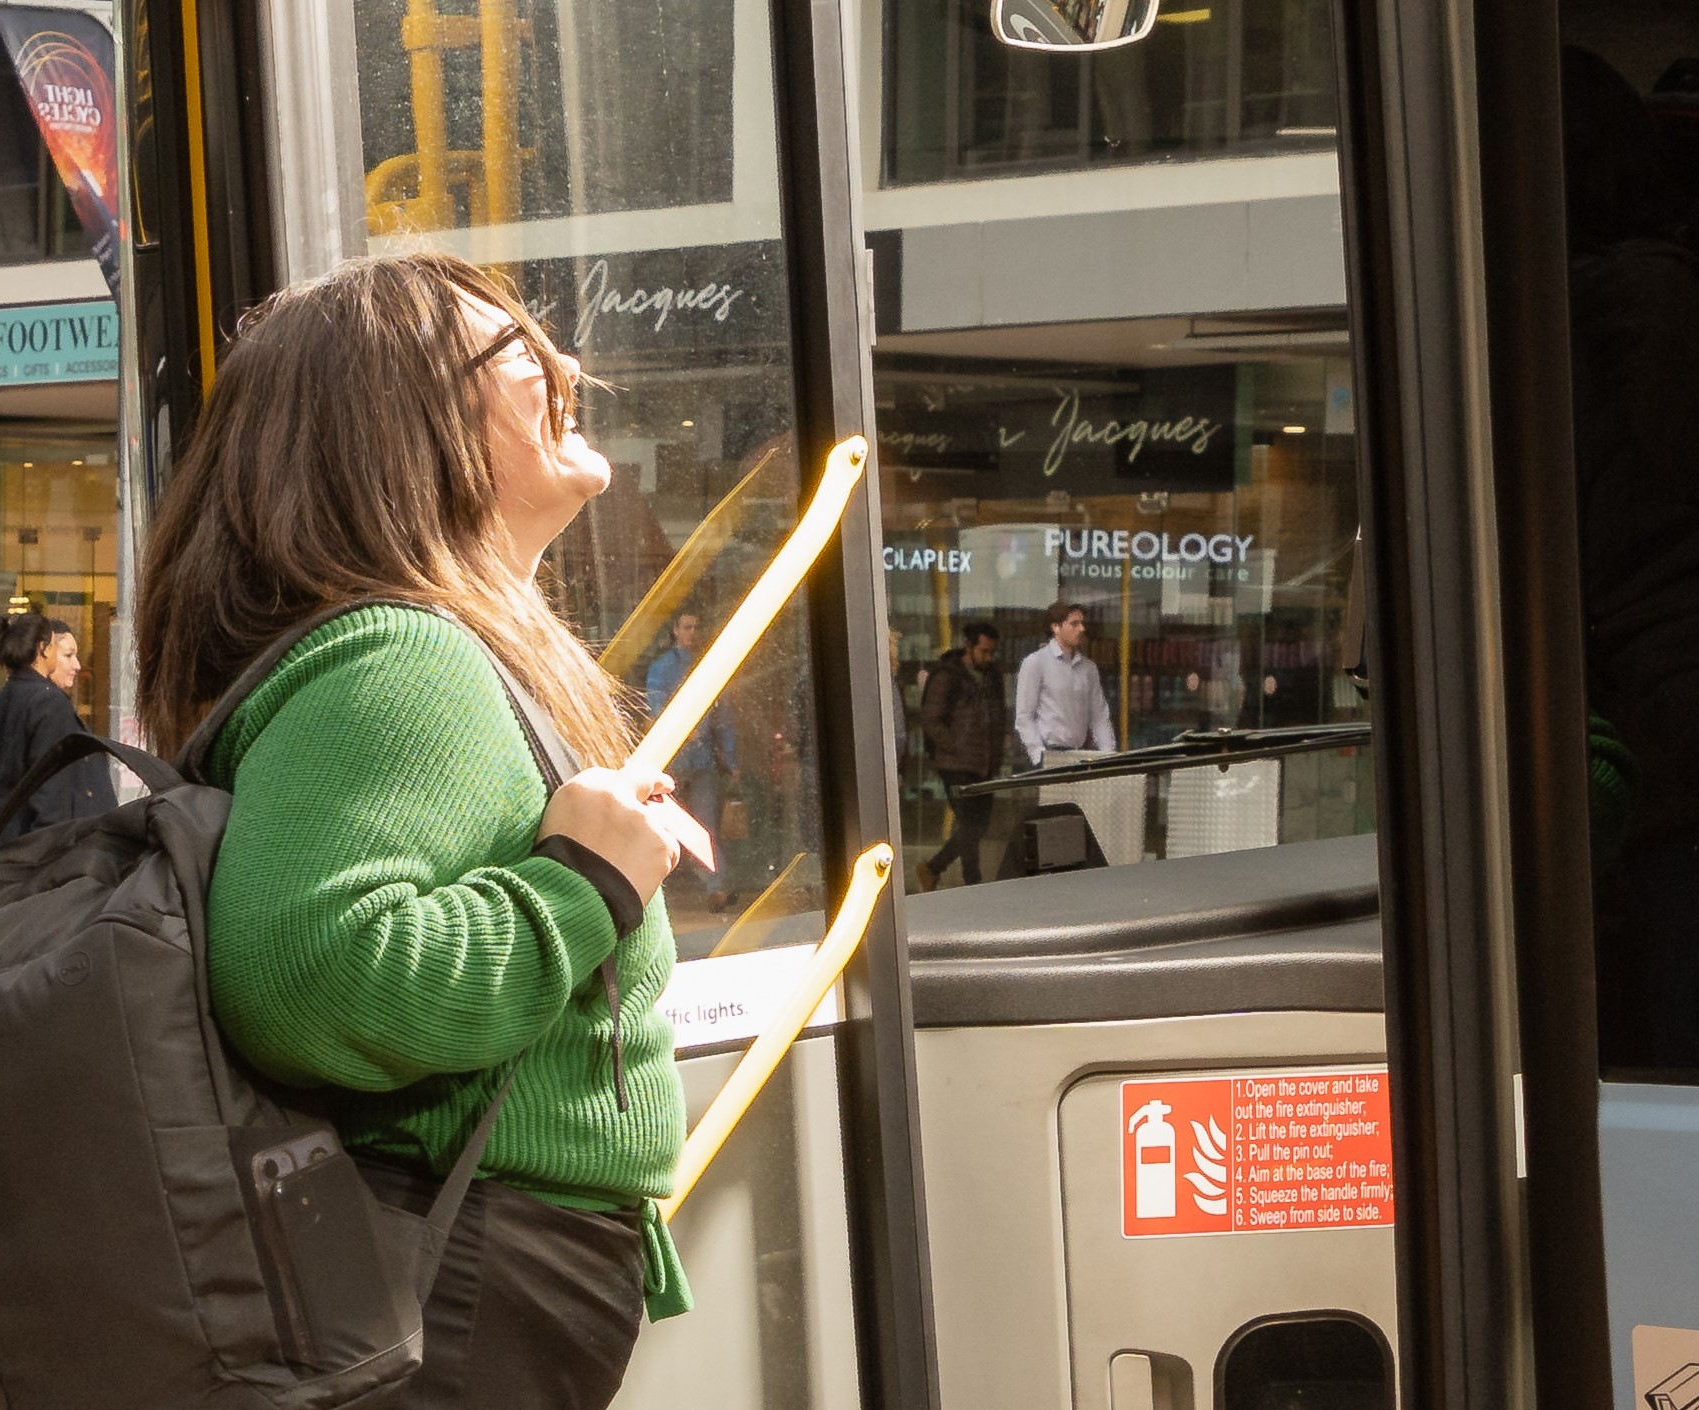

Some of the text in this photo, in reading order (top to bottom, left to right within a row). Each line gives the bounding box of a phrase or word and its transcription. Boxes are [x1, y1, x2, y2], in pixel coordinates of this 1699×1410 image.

[574, 259, 744, 347] Jacques
[24, 364, 49, 376] GIFTS
[1044, 388, 1222, 476] Jacques
[1043, 528, 1254, 564] PUREOLOGY
[1130, 561, 1196, 581] colour
[697, 1001, 749, 1024] lights.
[1235, 1075, 1379, 1100] 1.Open the cover and take
[1235, 1097, 1366, 1120] out the fire extinguisher;
[1235, 1119, 1380, 1141] 2. Lift the fire extinguisher;
[1235, 1142, 1333, 1164] 3. Pull the pin out;
[1235, 1160, 1390, 1183] 4. Aim at the base of the fire;
[1235, 1181, 1394, 1207] 5. Squeeze the handle firmly;
[1235, 1203, 1382, 1227] 6. Sweep from side to side.
